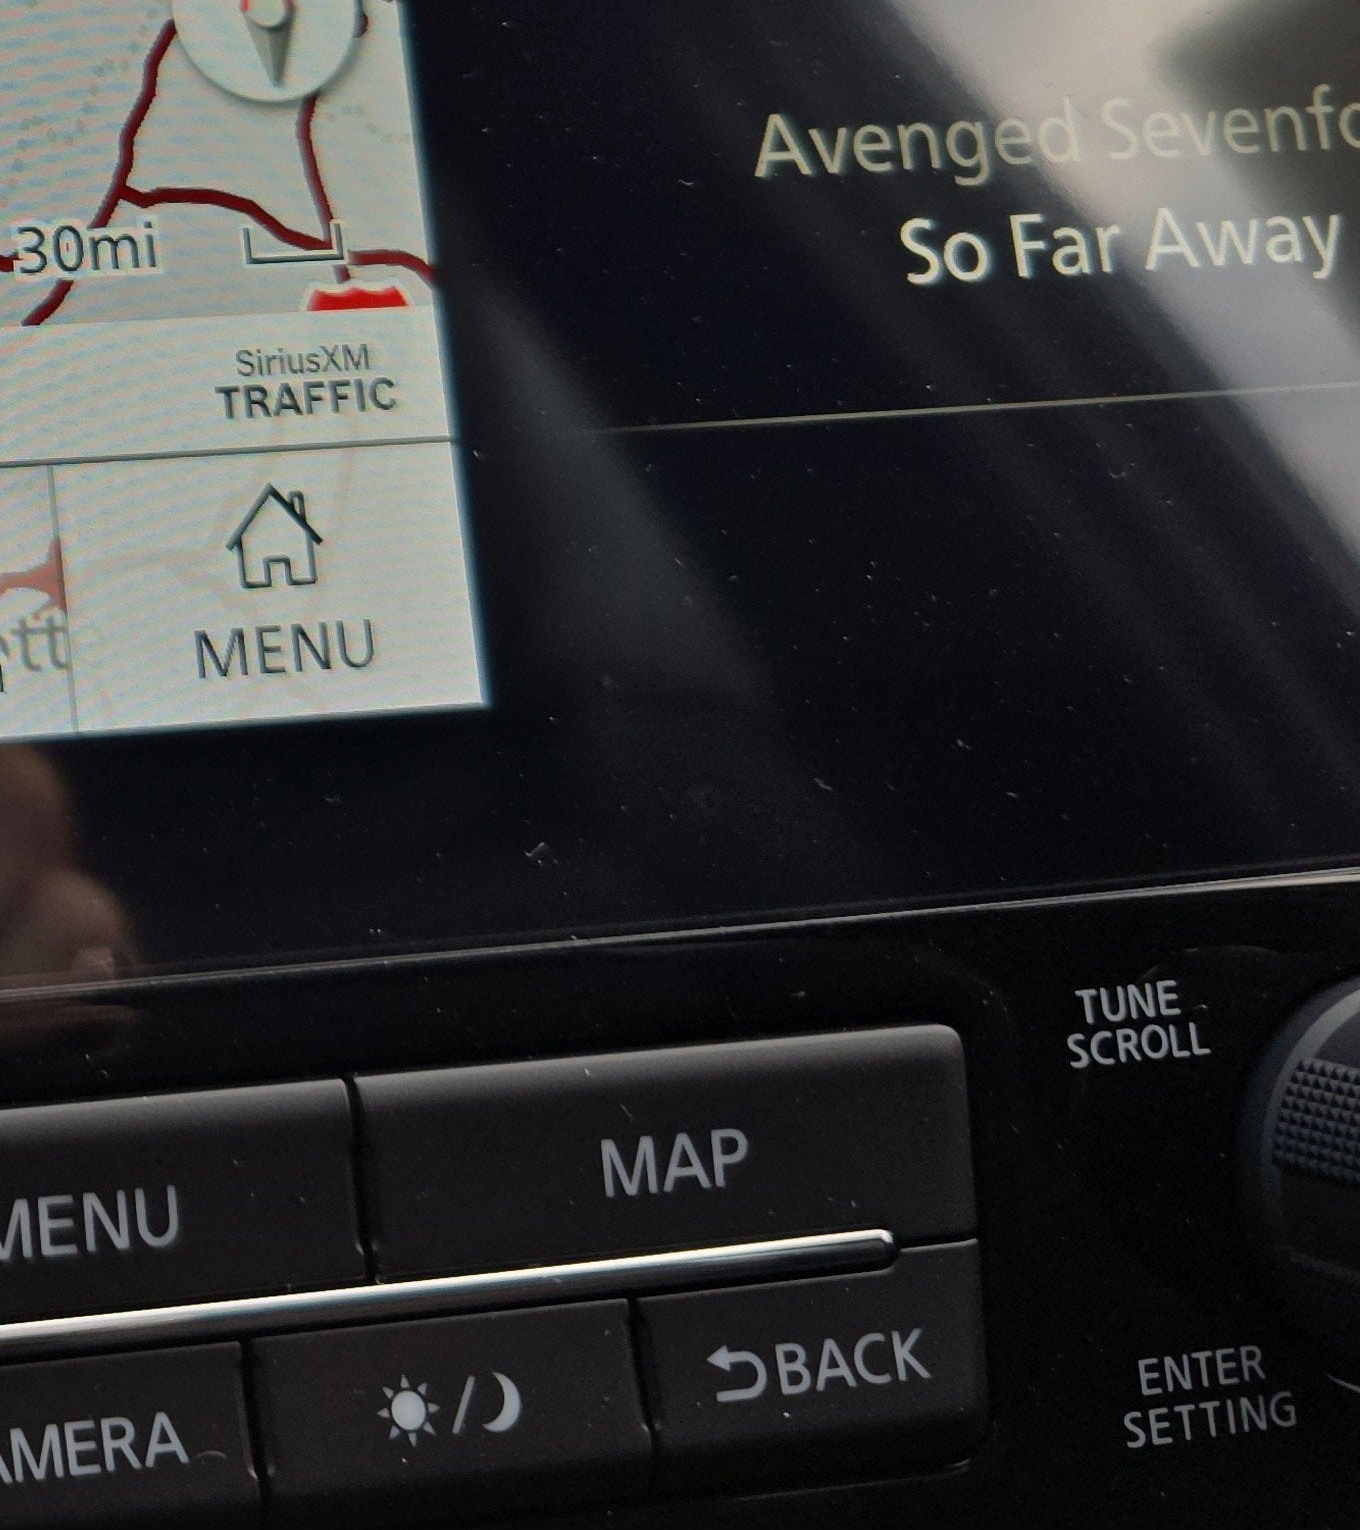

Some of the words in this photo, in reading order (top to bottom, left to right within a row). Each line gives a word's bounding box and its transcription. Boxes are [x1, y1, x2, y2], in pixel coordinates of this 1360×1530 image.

[754, 96, 1079, 186] Avenged
[18, 223, 157, 274] 30mi
[900, 217, 989, 285] So
[1009, 213, 1122, 278] Far
[1145, 207, 1341, 280] Away
[236, 343, 370, 377] SiriusXM
[215, 376, 397, 420] TRAFFIC
[195, 618, 376, 680] MENU
[1074, 980, 1182, 1024] TUNE
[1066, 1022, 1212, 1069] SCROLL
[599, 1127, 749, 1198] MAP
[775, 1328, 933, 1396] BACK
[1137, 1345, 1268, 1397] ENTER
[1123, 1391, 1298, 1449] SETTING
